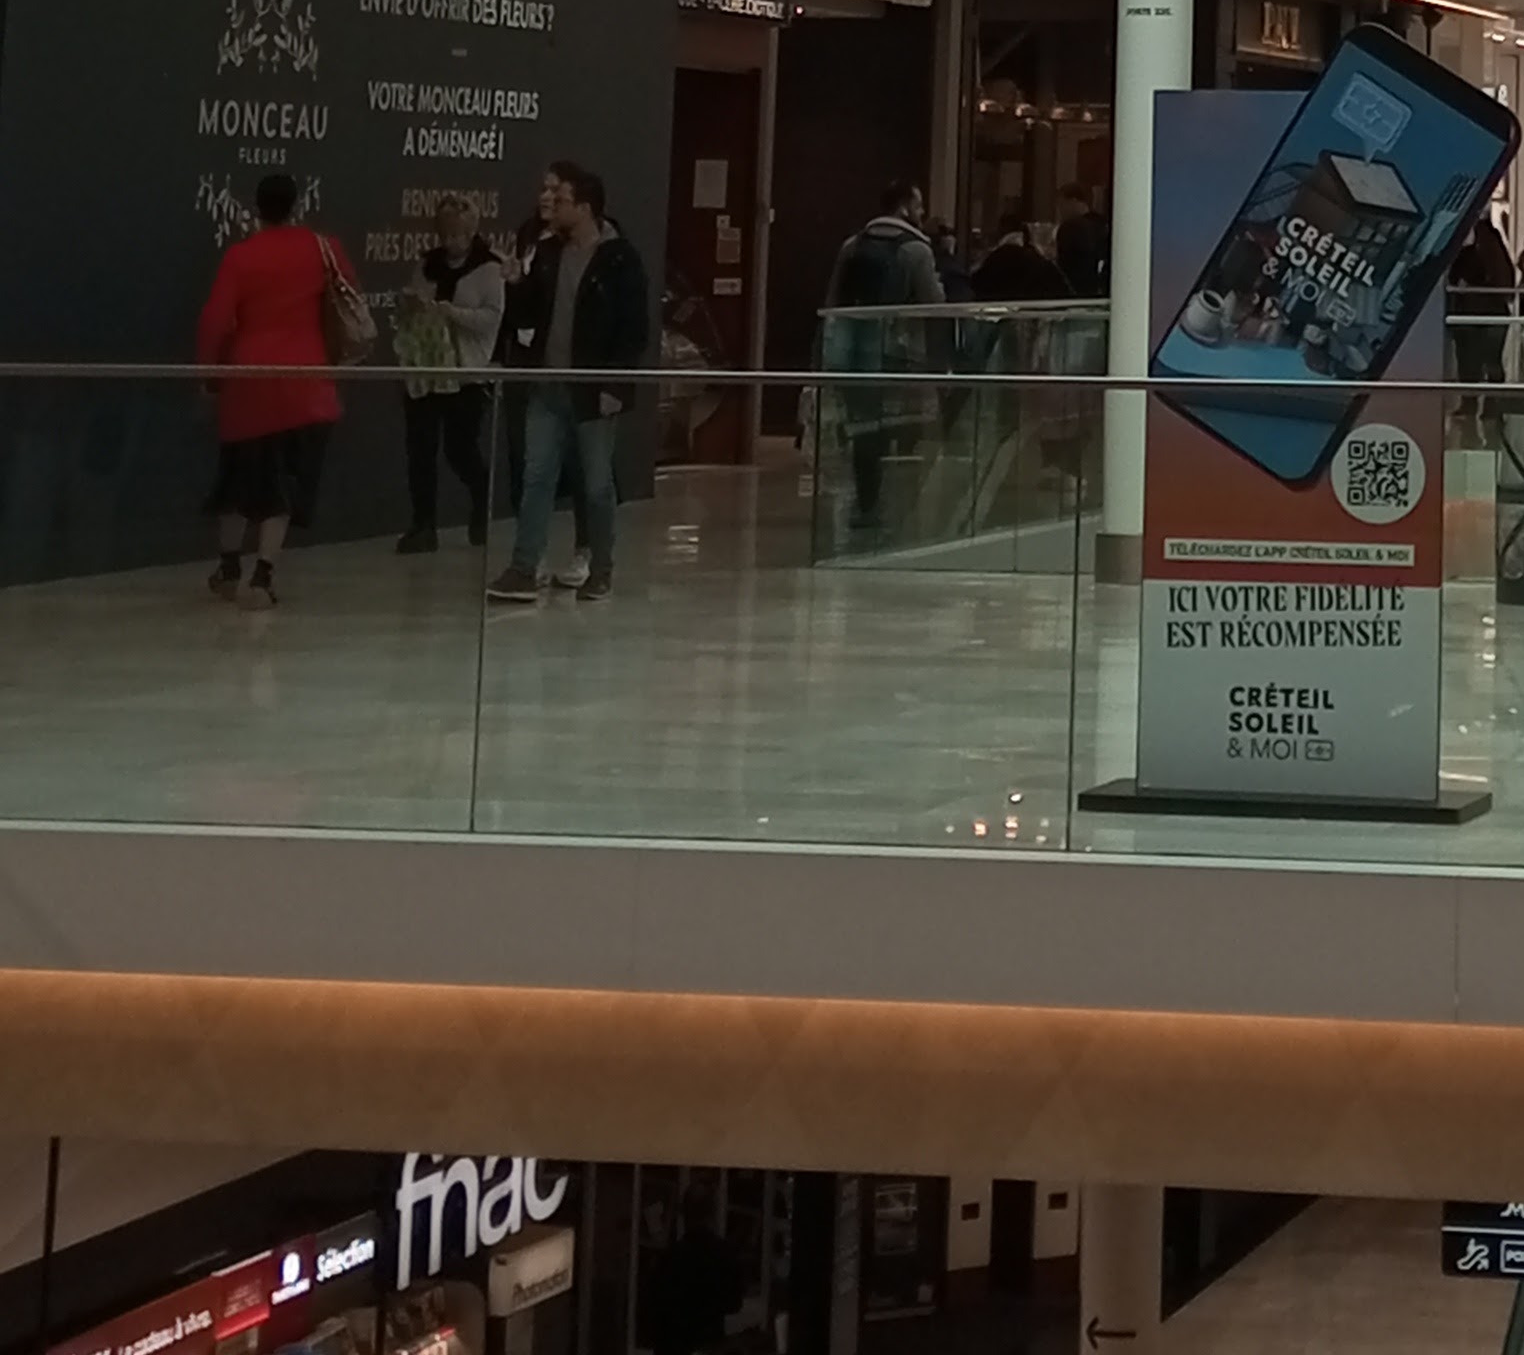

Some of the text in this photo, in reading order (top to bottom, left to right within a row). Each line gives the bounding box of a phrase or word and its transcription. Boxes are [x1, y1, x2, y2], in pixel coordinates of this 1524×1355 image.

[367, 80, 540, 121] VOTRE MONCEAU FLEURS
[198, 98, 329, 141] MONCEAU
[238, 146, 287, 166] FLEURS
[402, 126, 416, 157] A
[1274, 236, 1351, 298] SOLEIL
[1286, 216, 1375, 287] CRÉTEIL
[1261, 256, 1327, 307] & MOI
[1375, 548, 1384, 561] &
[1387, 549, 1410, 561] MOI
[1168, 585, 1198, 613] ICI
[1205, 585, 1288, 613] VOTRE
[1166, 613, 1403, 649] EST RÉCOMPENSÉE
[1229, 682, 1335, 710] CRÉTEIL
[1228, 712, 1320, 736] SOLEIL
[1226, 736, 1298, 761] & MOI
[395, 1152, 569, 1291] fnac
